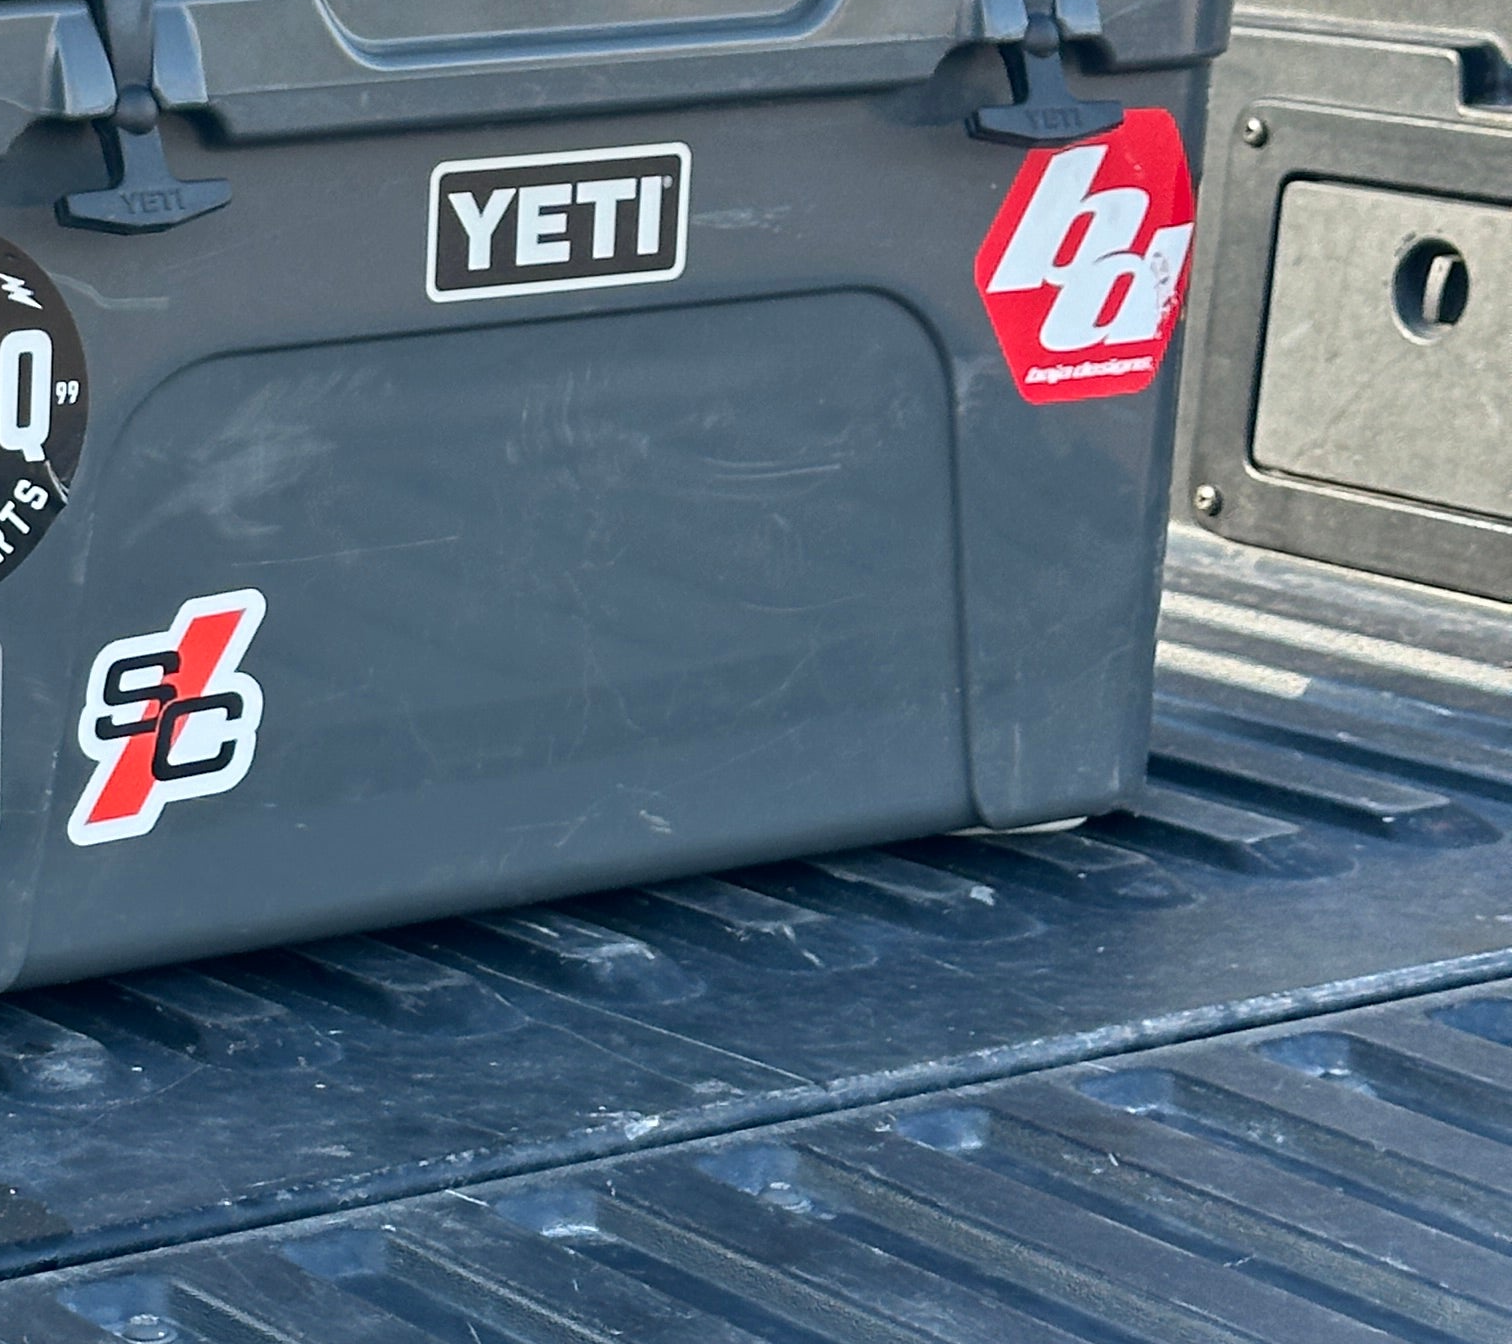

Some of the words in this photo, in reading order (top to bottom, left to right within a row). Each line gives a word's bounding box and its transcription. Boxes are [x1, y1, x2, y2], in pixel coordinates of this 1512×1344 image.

[119, 188, 187, 214] YETI
[448, 175, 663, 271] YETI
[55, 381, 80, 405] 99
